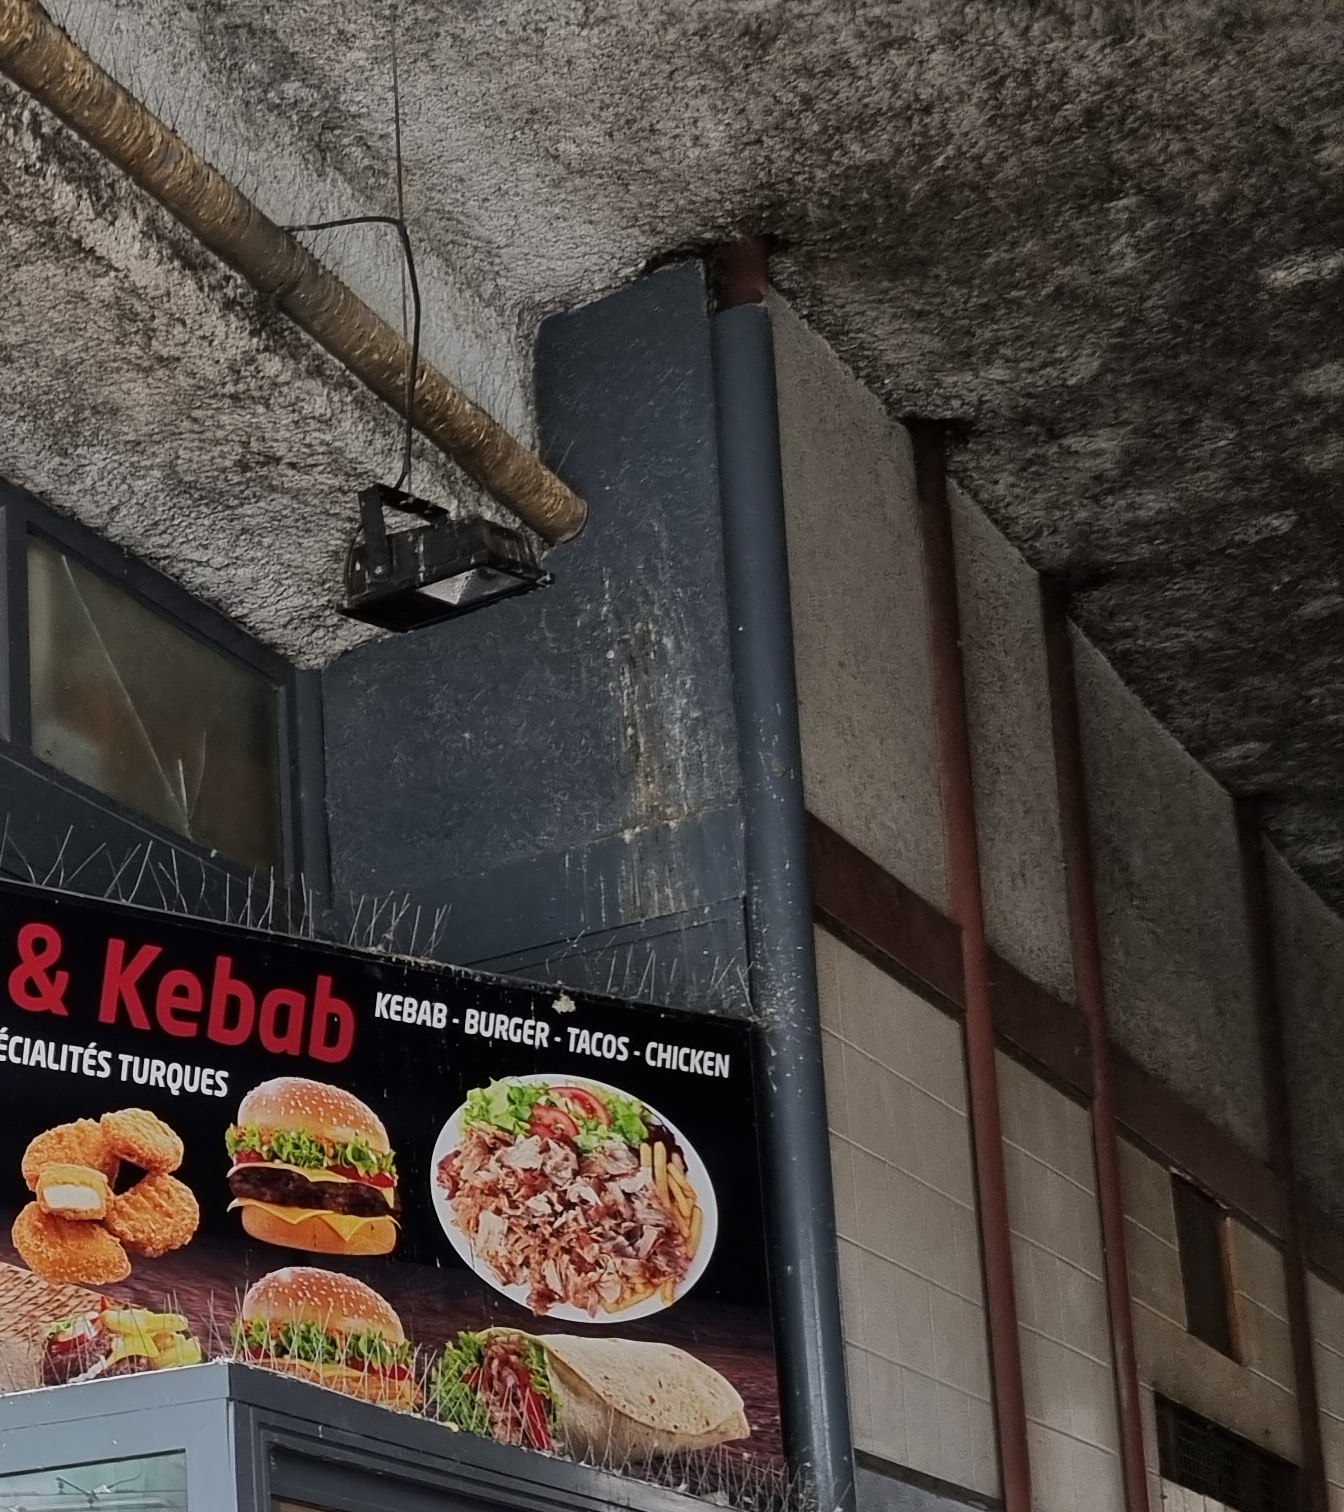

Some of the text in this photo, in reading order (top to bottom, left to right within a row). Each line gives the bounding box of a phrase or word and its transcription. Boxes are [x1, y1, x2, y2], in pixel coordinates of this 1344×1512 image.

[7, 923, 70, 1016] &
[97, 938, 357, 1064] Kebab
[374, 991, 448, 1029] KEBAB
[463, 1006, 549, 1049] BURGER
[566, 1023, 630, 1062] TACOS
[645, 1036, 731, 1079] CHICKEN
[118, 1052, 229, 1099] TURQUES
